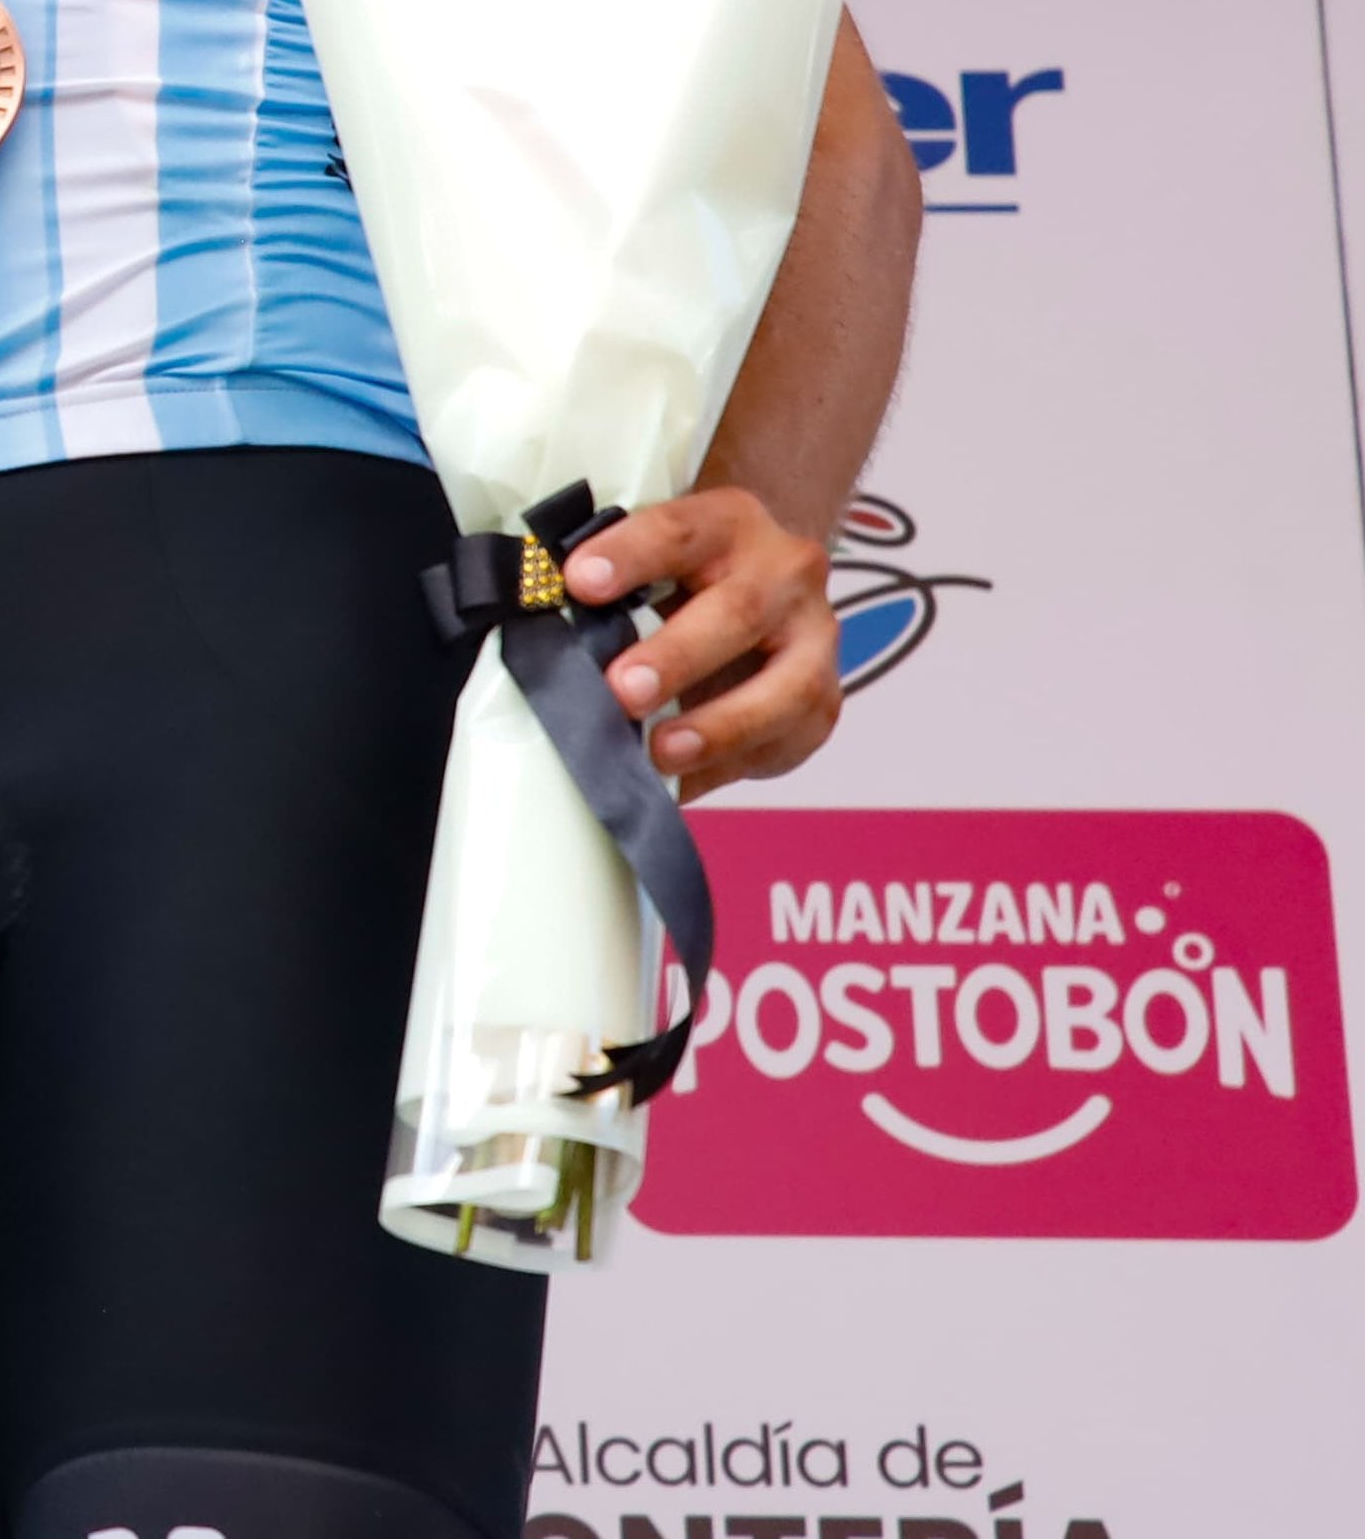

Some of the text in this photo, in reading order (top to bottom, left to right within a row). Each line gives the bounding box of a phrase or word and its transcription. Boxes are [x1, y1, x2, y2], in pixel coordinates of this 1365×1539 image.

[769, 881, 1126, 945] MANZANA
[530, 1419, 985, 1490] Alcaldía de
